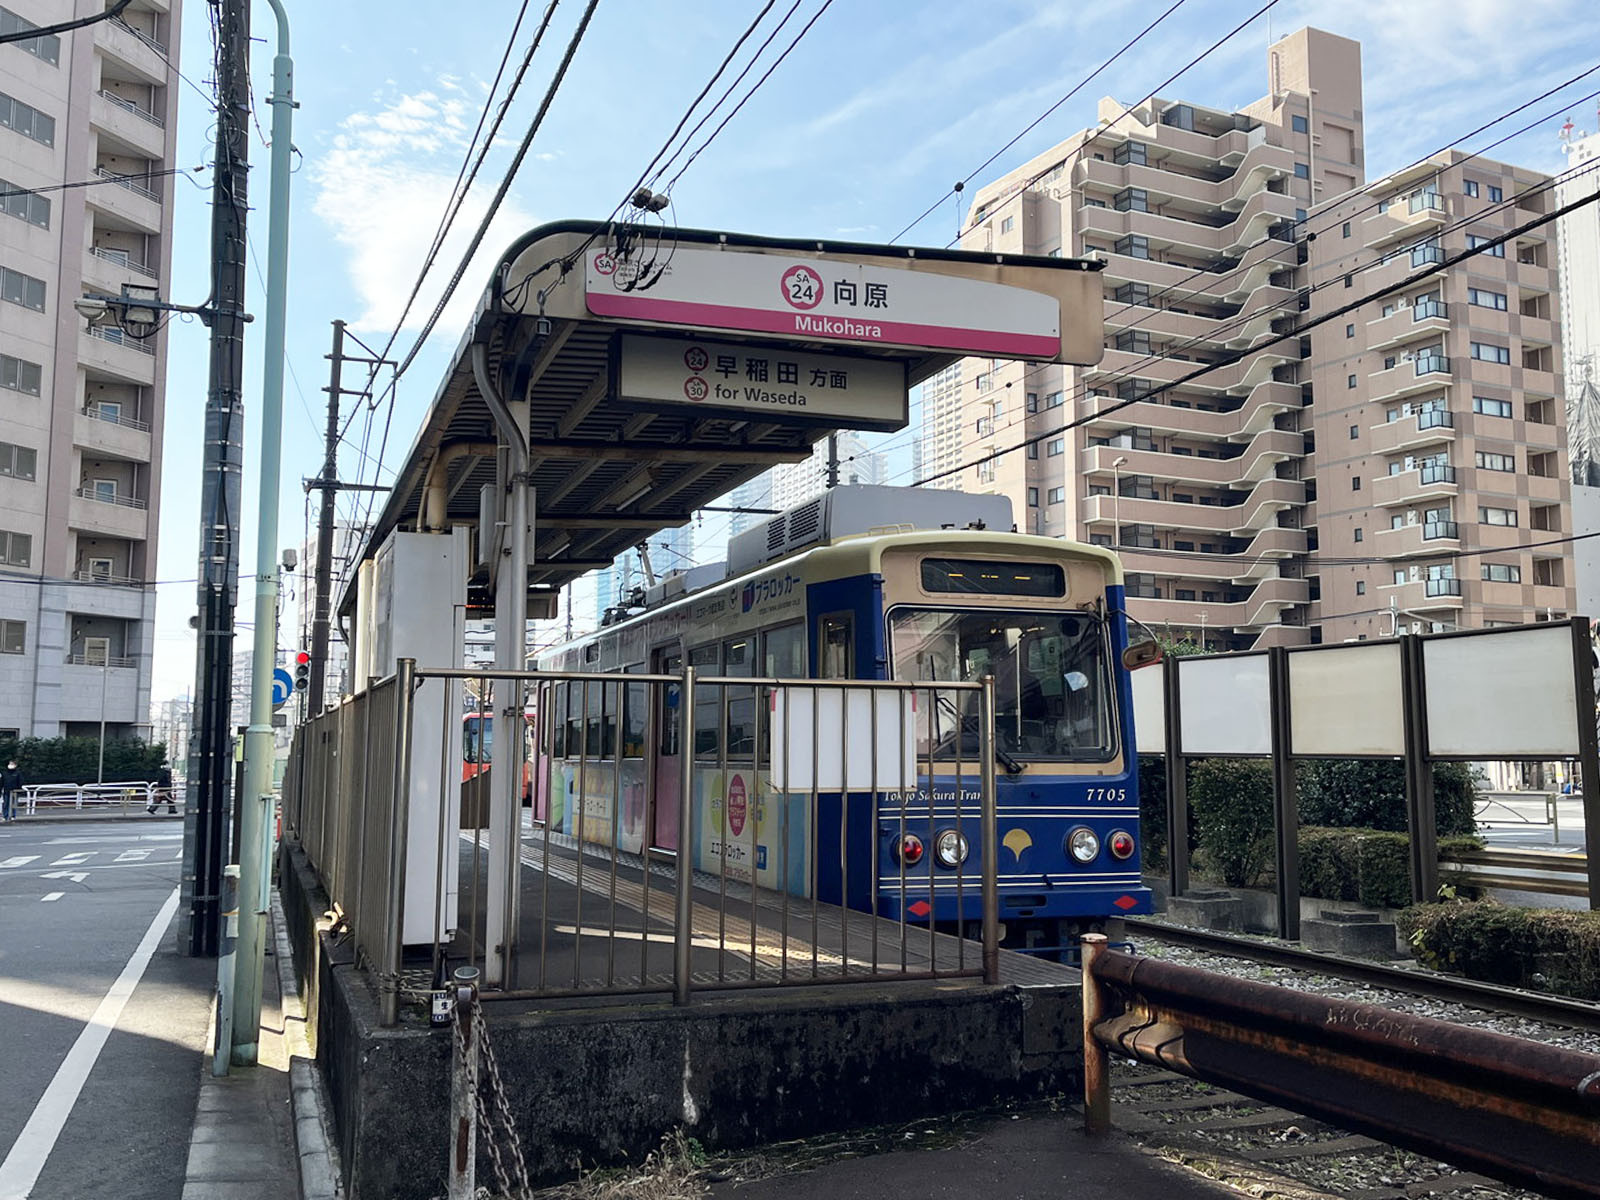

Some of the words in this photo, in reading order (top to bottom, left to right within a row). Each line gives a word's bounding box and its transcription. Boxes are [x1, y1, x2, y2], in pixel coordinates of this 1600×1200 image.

[599, 259, 612, 269] SA
[796, 273, 810, 283] SA
[792, 284, 813, 300] 24
[833, 279, 888, 309] 向原
[795, 315, 882, 338] Mukohara
[690, 357, 703, 367] 24
[715, 355, 799, 385] 早稲田
[809, 368, 848, 390] 方面
[690, 386, 703, 397] 30
[714, 384, 739, 400] for
[743, 387, 807, 406] Waseda
[1087, 788, 1126, 802] 7705
